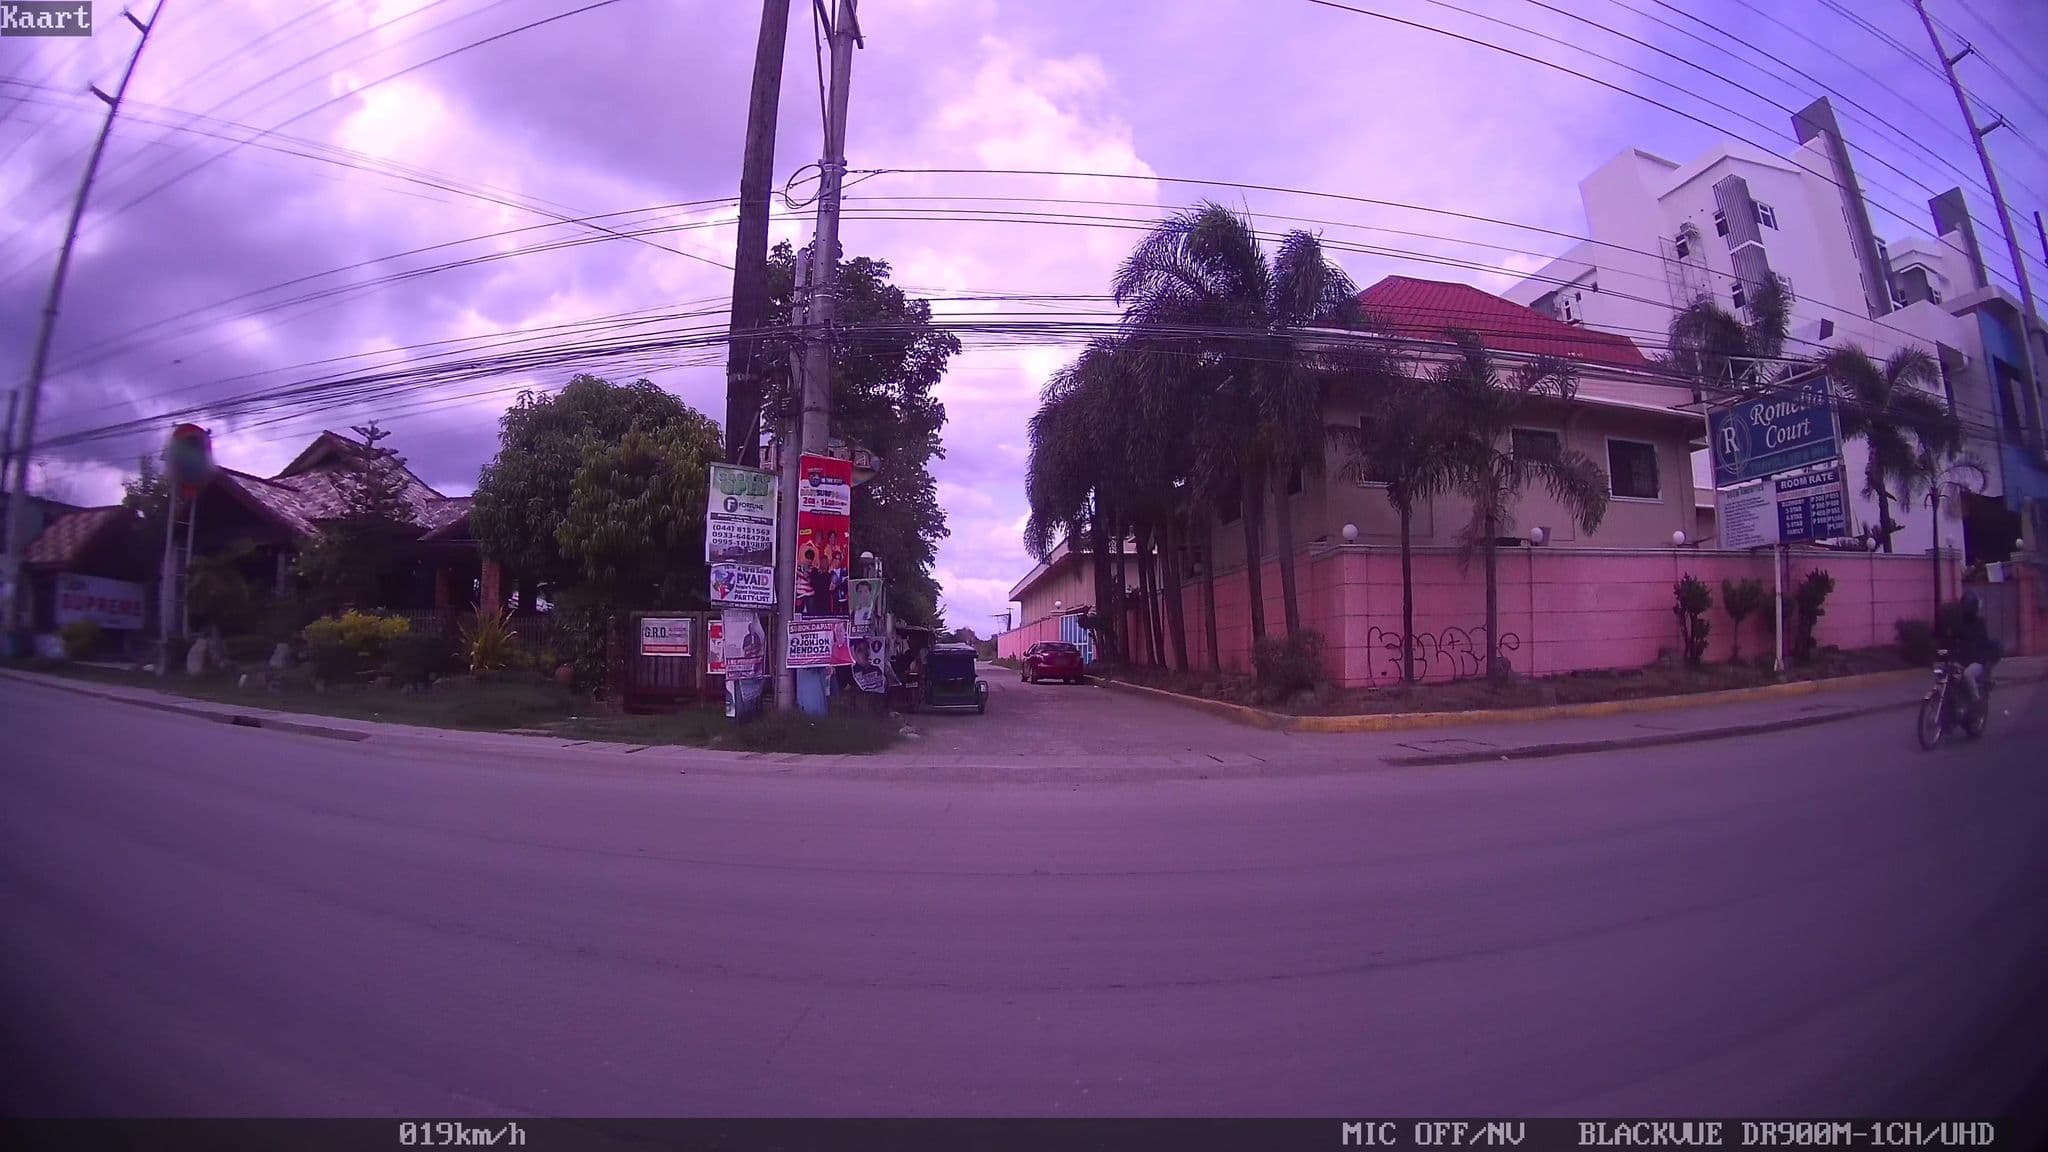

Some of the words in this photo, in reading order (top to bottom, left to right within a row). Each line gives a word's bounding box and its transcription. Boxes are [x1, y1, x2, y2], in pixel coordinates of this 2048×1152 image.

[1766, 418, 1811, 448] Court
[1722, 427, 1740, 454] R
[1781, 477, 1807, 490] ROOM
[1809, 472, 1834, 485] RATE
[712, 524, 734, 532] (044)
[736, 572, 769, 586] PVAID
[734, 594, 770, 602] PARTY-LIST
[790, 645, 830, 654] MENDOZA
